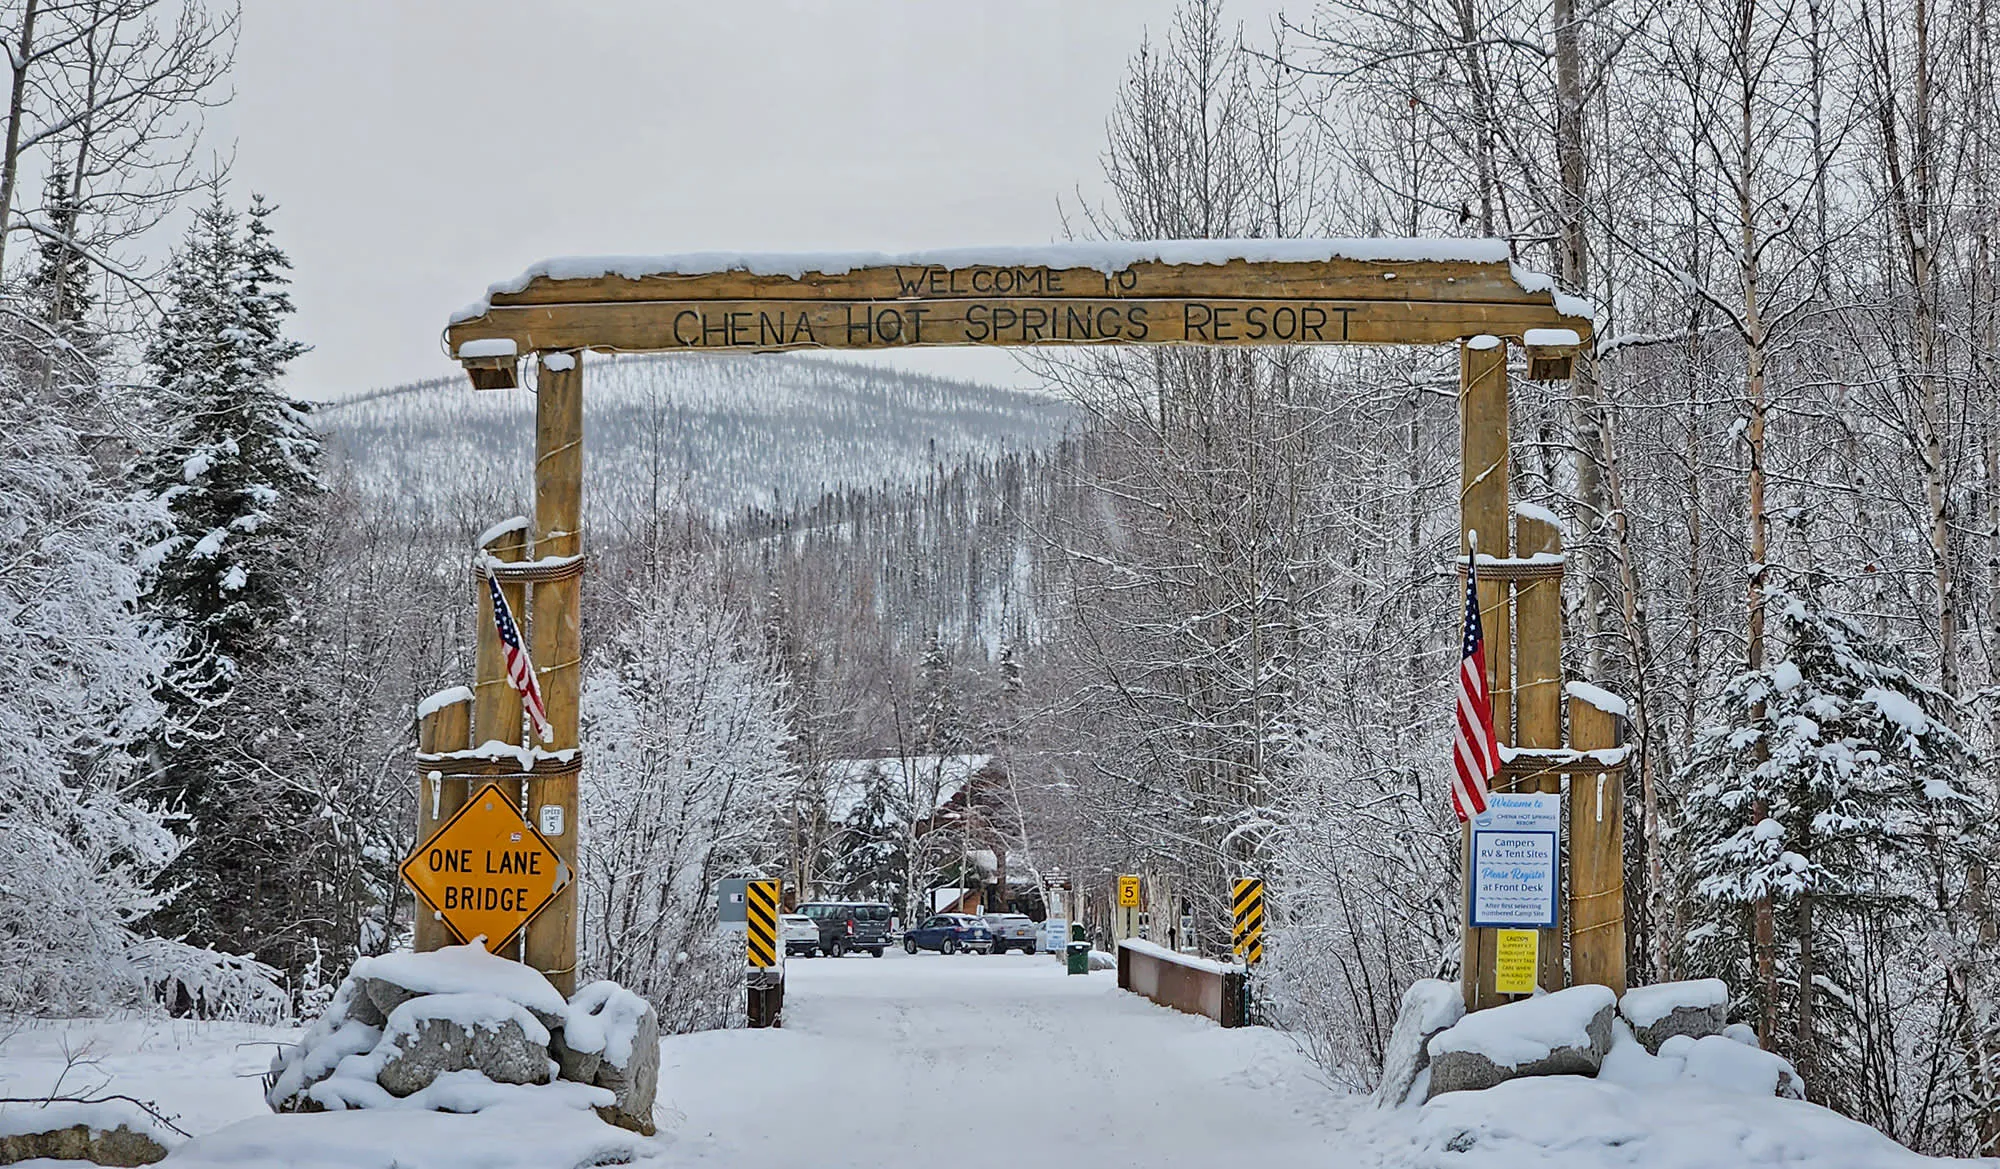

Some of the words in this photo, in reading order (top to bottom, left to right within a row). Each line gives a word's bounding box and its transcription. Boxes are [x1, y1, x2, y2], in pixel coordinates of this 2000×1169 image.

[896, 266, 1064, 296] WELCOME
[673, 309, 816, 346] CHENA
[847, 305, 930, 343] HOT
[965, 304, 1148, 342] SPRINGS
[1184, 303, 1356, 341] RESORT
[1489, 797, 1532, 808] Welcome
[1534, 800, 1543, 808] to
[549, 821, 556, 832] 5
[1494, 838, 1535, 848] Campers
[1481, 849, 1493, 858] RV
[1495, 850, 1502, 858] &
[1504, 850, 1525, 858] Tent
[1526, 850, 1548, 858] Sites
[429, 848, 472, 873] ONE
[486, 850, 542, 875] LANE
[1482, 867, 1509, 879] Please
[1510, 867, 1545, 882] Register
[1124, 886, 1134, 898] 5
[1483, 884, 1491, 892] at
[1494, 884, 1519, 892] Front
[1521, 883, 1543, 892] Desk
[444, 886, 529, 912] BRIDGE
